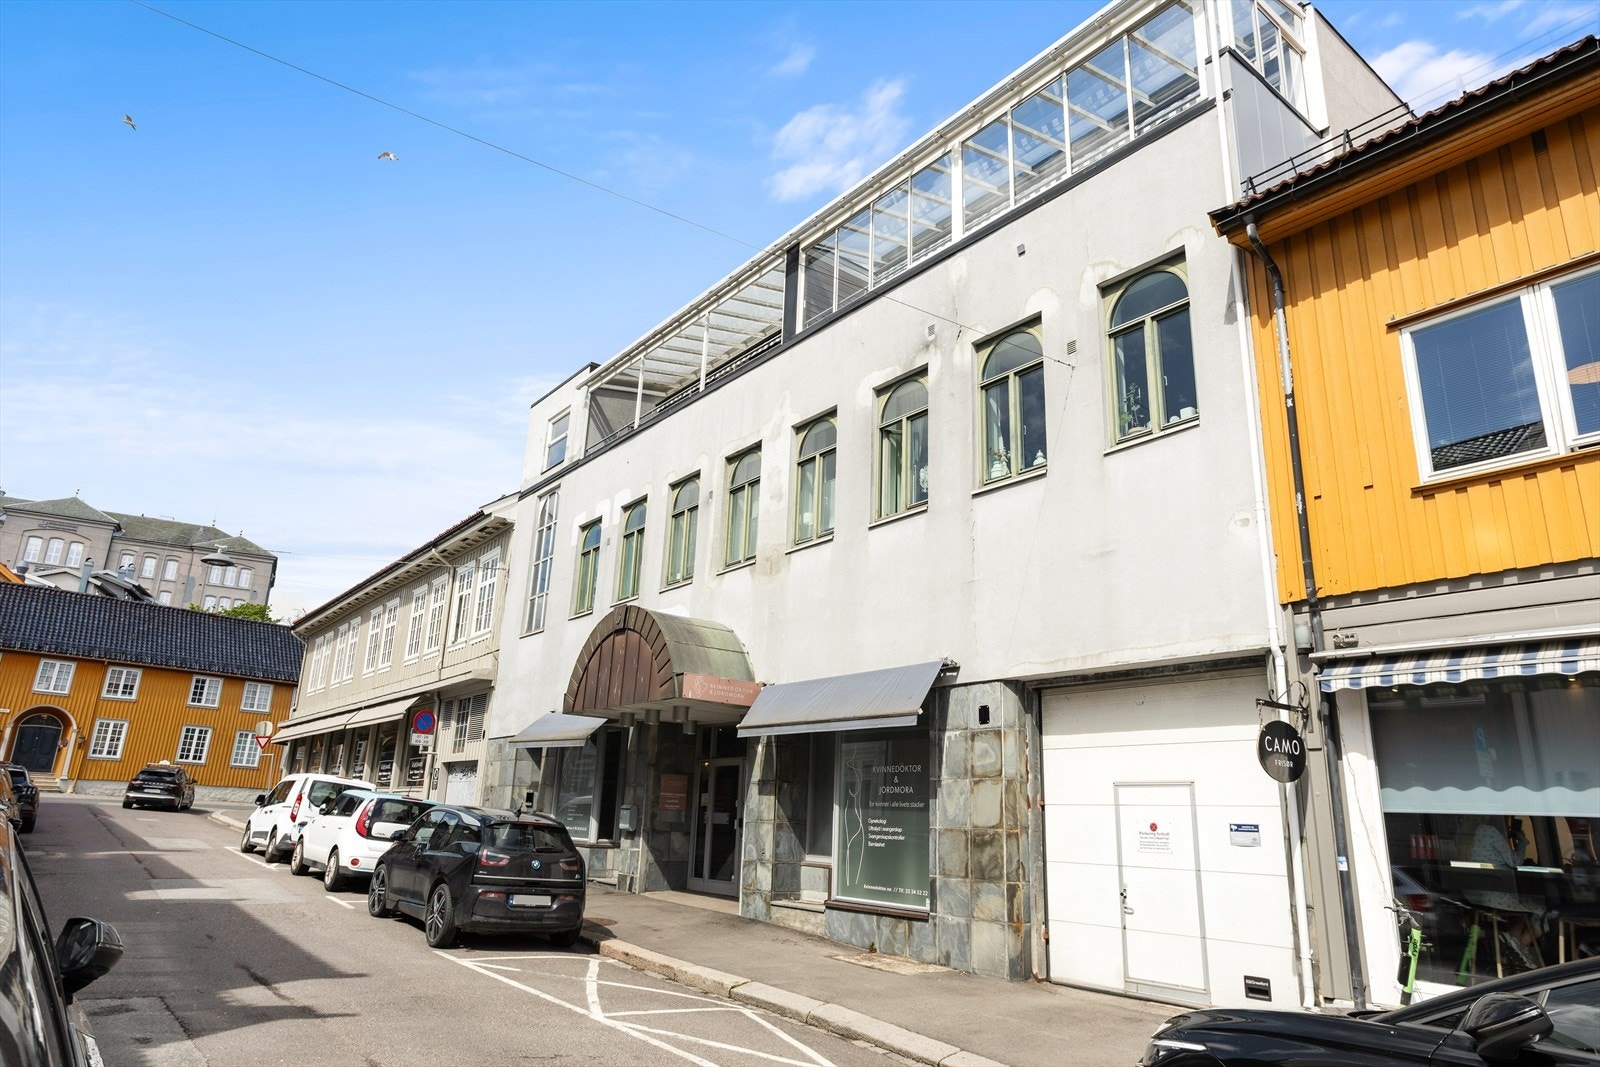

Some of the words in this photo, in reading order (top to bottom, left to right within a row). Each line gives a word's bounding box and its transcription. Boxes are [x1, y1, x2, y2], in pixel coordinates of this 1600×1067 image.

[709, 684, 753, 694] KVINNEDOKTOR
[1264, 736, 1300, 756] CAMO
[1274, 759, 1294, 768] FRISØR
[872, 764, 922, 773] KVINNEDOKTOR
[894, 776, 898, 784] &
[878, 786, 914, 796] JORDMORA
